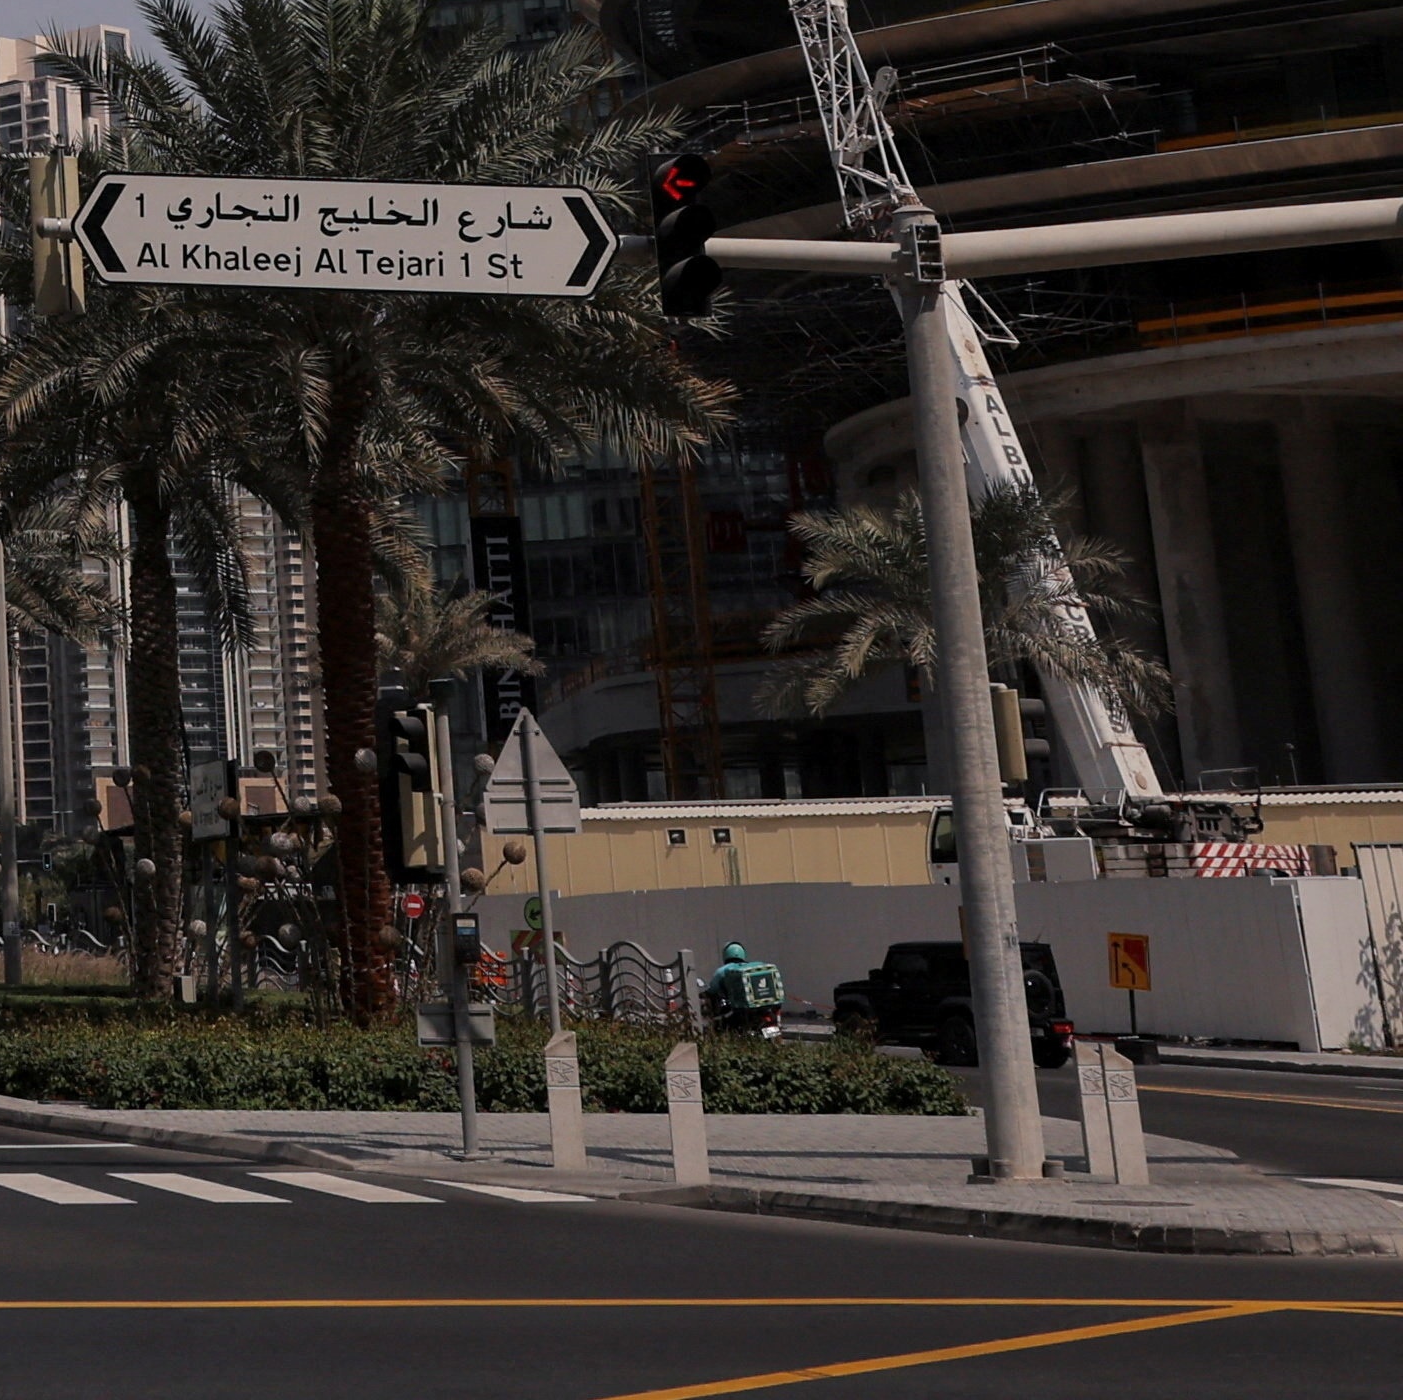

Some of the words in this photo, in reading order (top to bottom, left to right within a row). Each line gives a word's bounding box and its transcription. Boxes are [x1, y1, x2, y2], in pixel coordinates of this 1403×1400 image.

[135, 192, 145, 218] 1
[166, 191, 301, 231] التجاري
[318, 197, 439, 237] الخليج
[457, 200, 553, 243] شارع
[136, 242, 170, 269] Al
[182, 243, 302, 279] Khaleej
[314, 247, 348, 274] Al
[355, 248, 445, 282] Tejari
[459, 252, 470, 278] 1
[487, 253, 523, 279] St
[485, 536, 522, 720] BINHATTI
